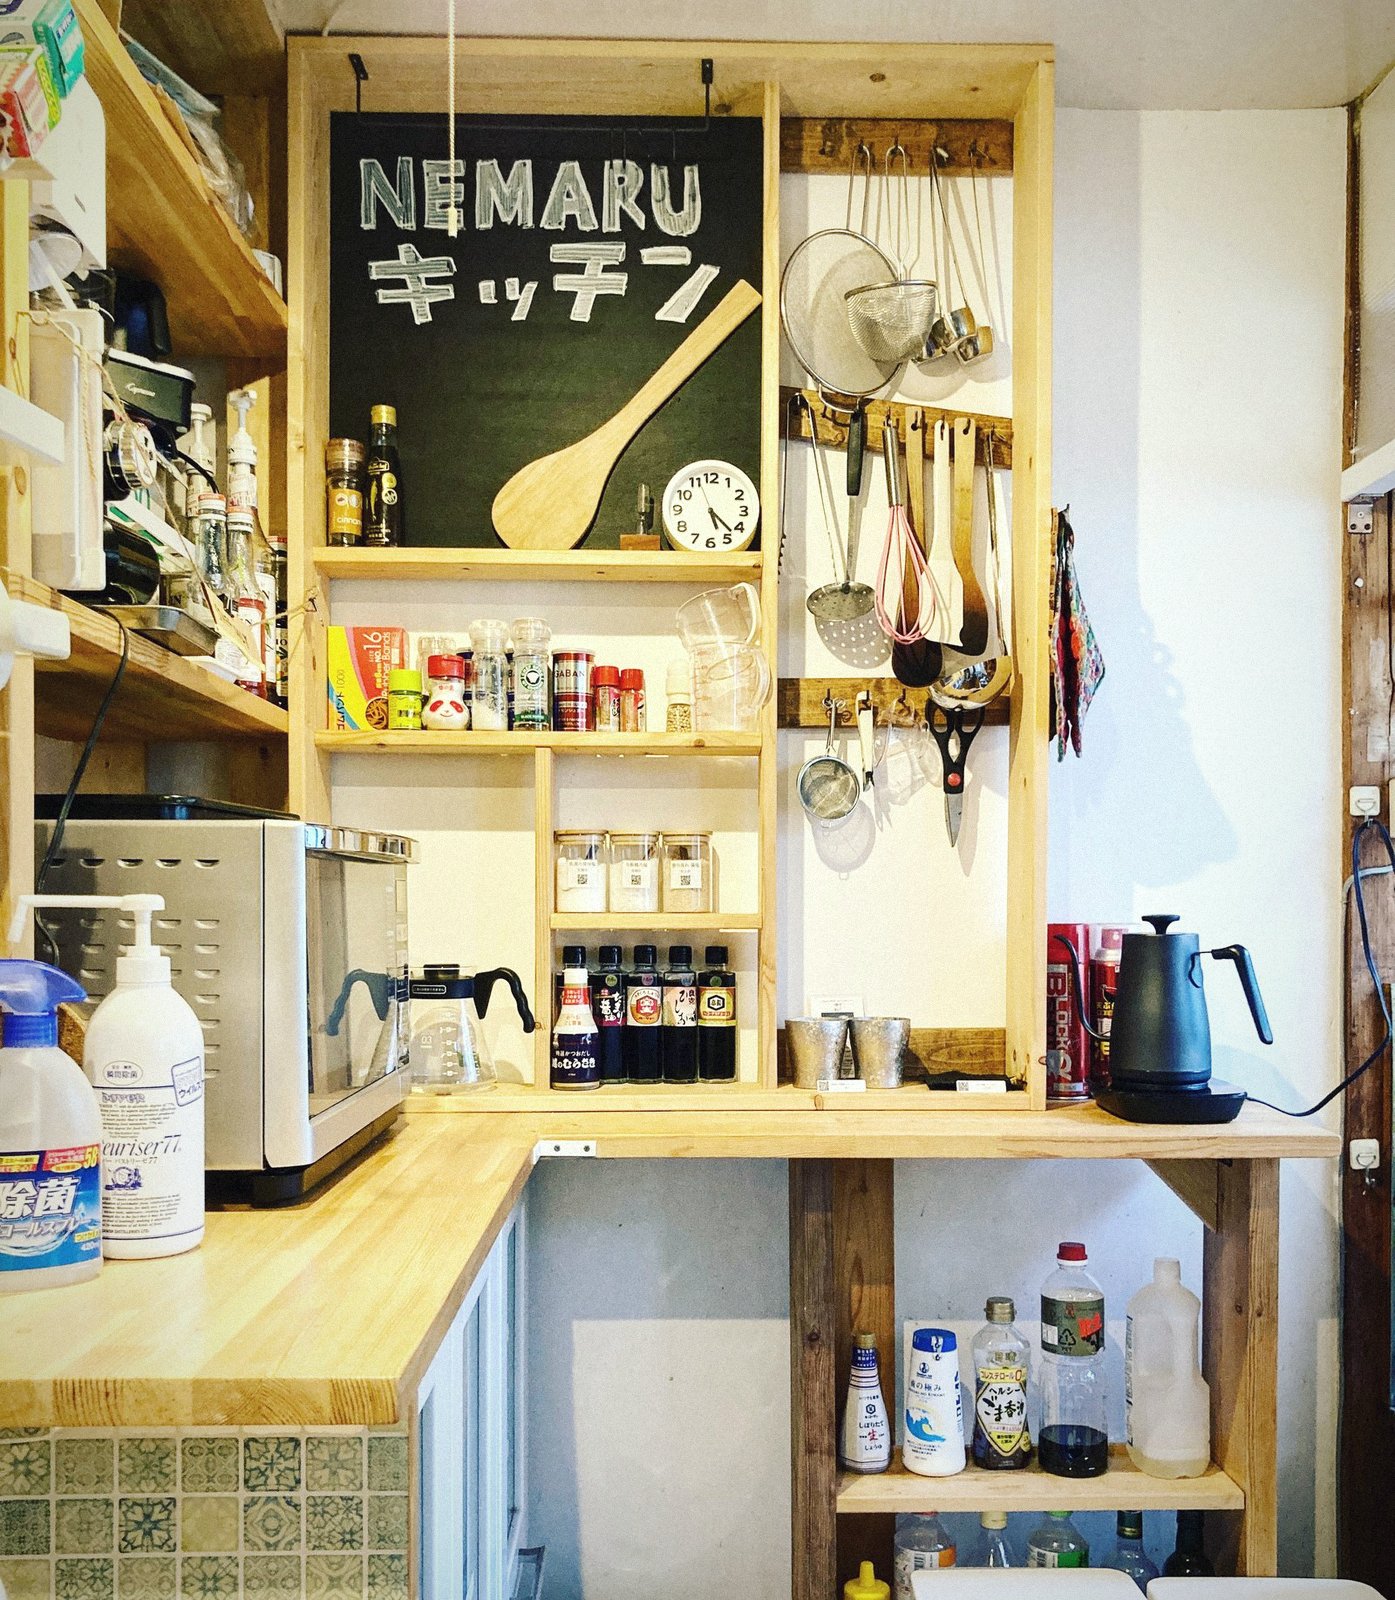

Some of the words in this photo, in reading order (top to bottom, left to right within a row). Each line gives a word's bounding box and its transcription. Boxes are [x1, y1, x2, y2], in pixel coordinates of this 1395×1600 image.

[360, 157, 702, 237] NEMARU
[368, 242, 721, 325] キッチン
[689, 477, 701, 487] 11
[703, 472, 719, 484] 12
[725, 477, 731, 488] 1
[677, 490, 692, 500] 10
[734, 489, 744, 500] 2
[673, 504, 683, 515] 9
[739, 506, 748, 516] 3
[677, 521, 687, 532] 8
[734, 521, 744, 533] 4
[691, 533, 699, 544] 7
[705, 538, 716, 548] 6
[722, 534, 732, 544] 5
[382, 632, 391, 660] Bands
[336, 692, 345, 730] ゴムバンド
[0, 1175, 80, 1220] 除菌
[989, 1386, 1020, 1396] ヘルシー
